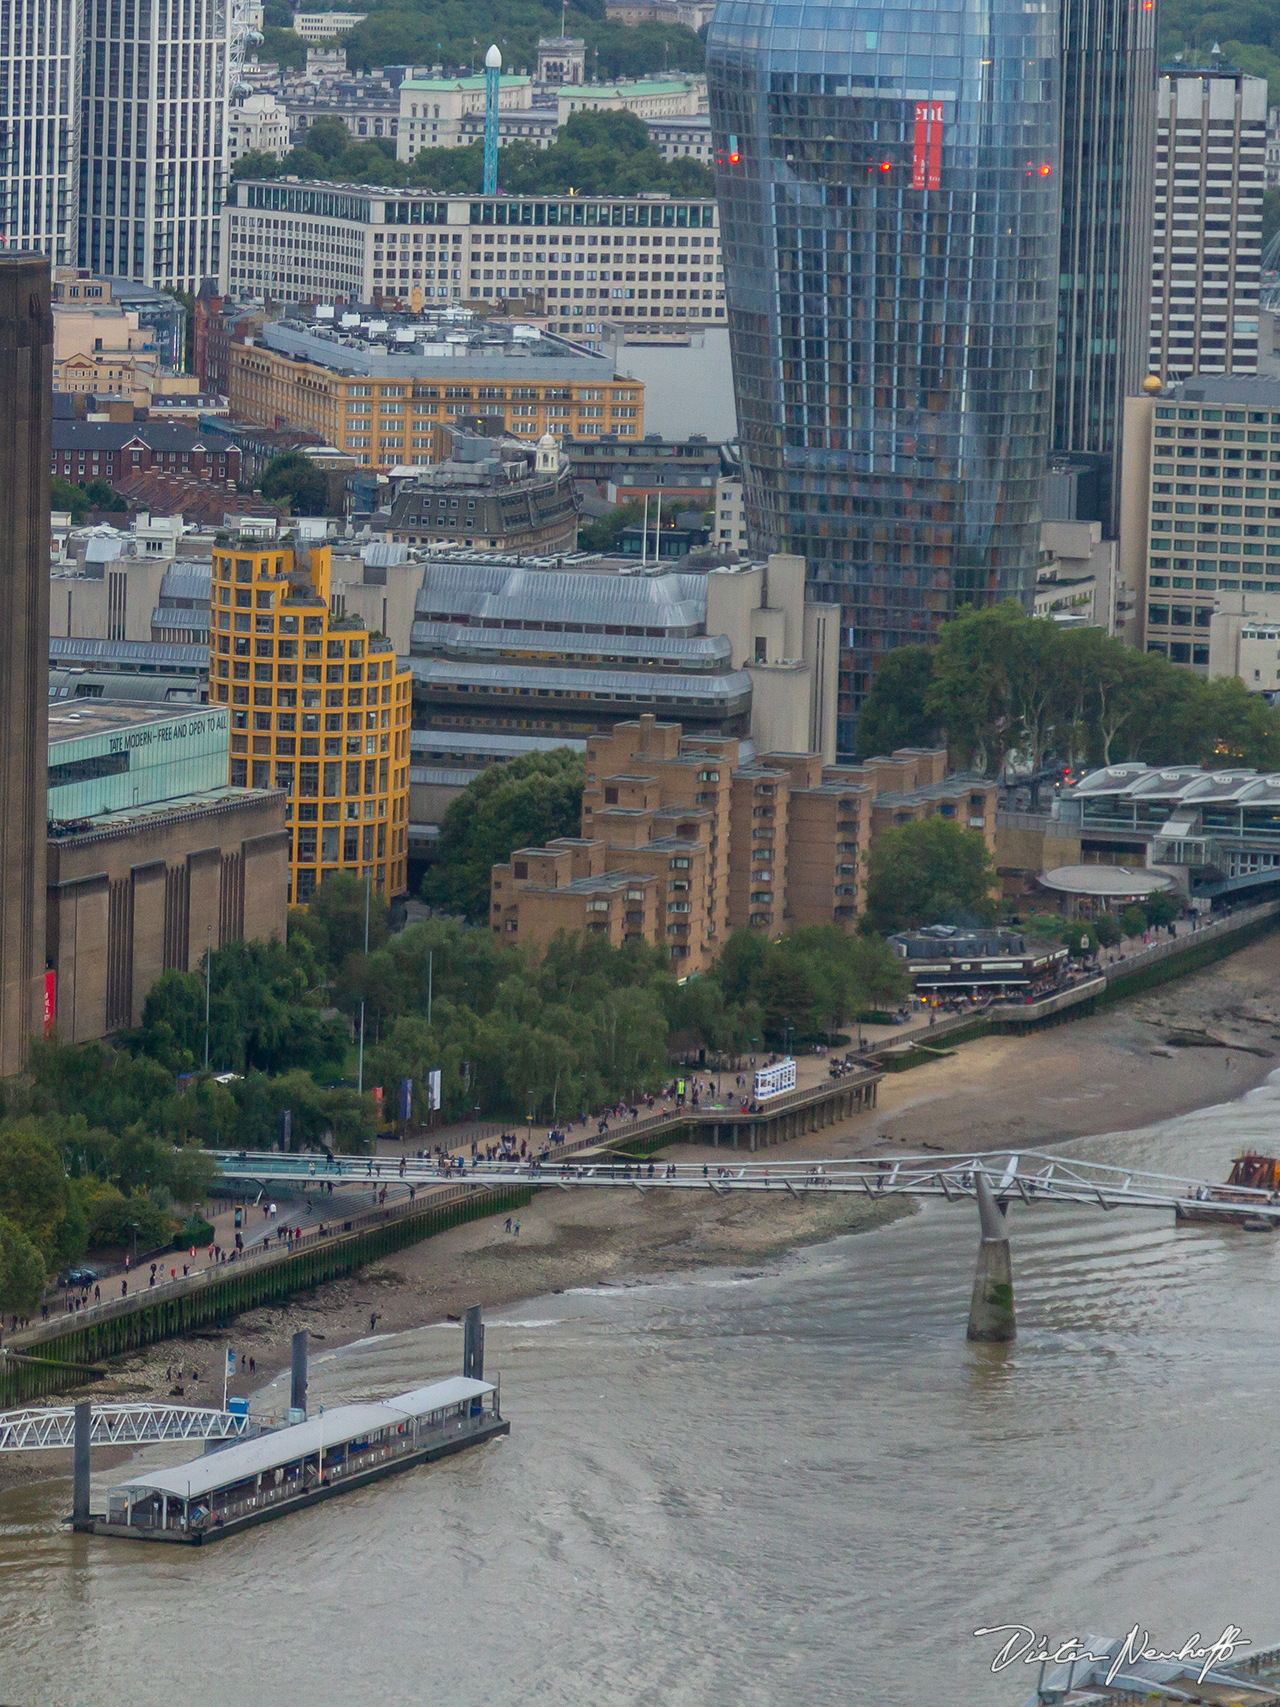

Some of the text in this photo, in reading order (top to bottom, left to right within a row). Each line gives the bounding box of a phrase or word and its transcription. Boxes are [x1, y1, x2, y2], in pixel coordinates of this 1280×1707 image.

[110, 737, 122, 752] TATE
[124, 731, 152, 749] MODERN
[158, 727, 172, 742] FREE
[173, 724, 187, 739] AND
[189, 721, 205, 736] OPEN
[208, 718, 215, 731] TO
[216, 716, 227, 730] ALL
